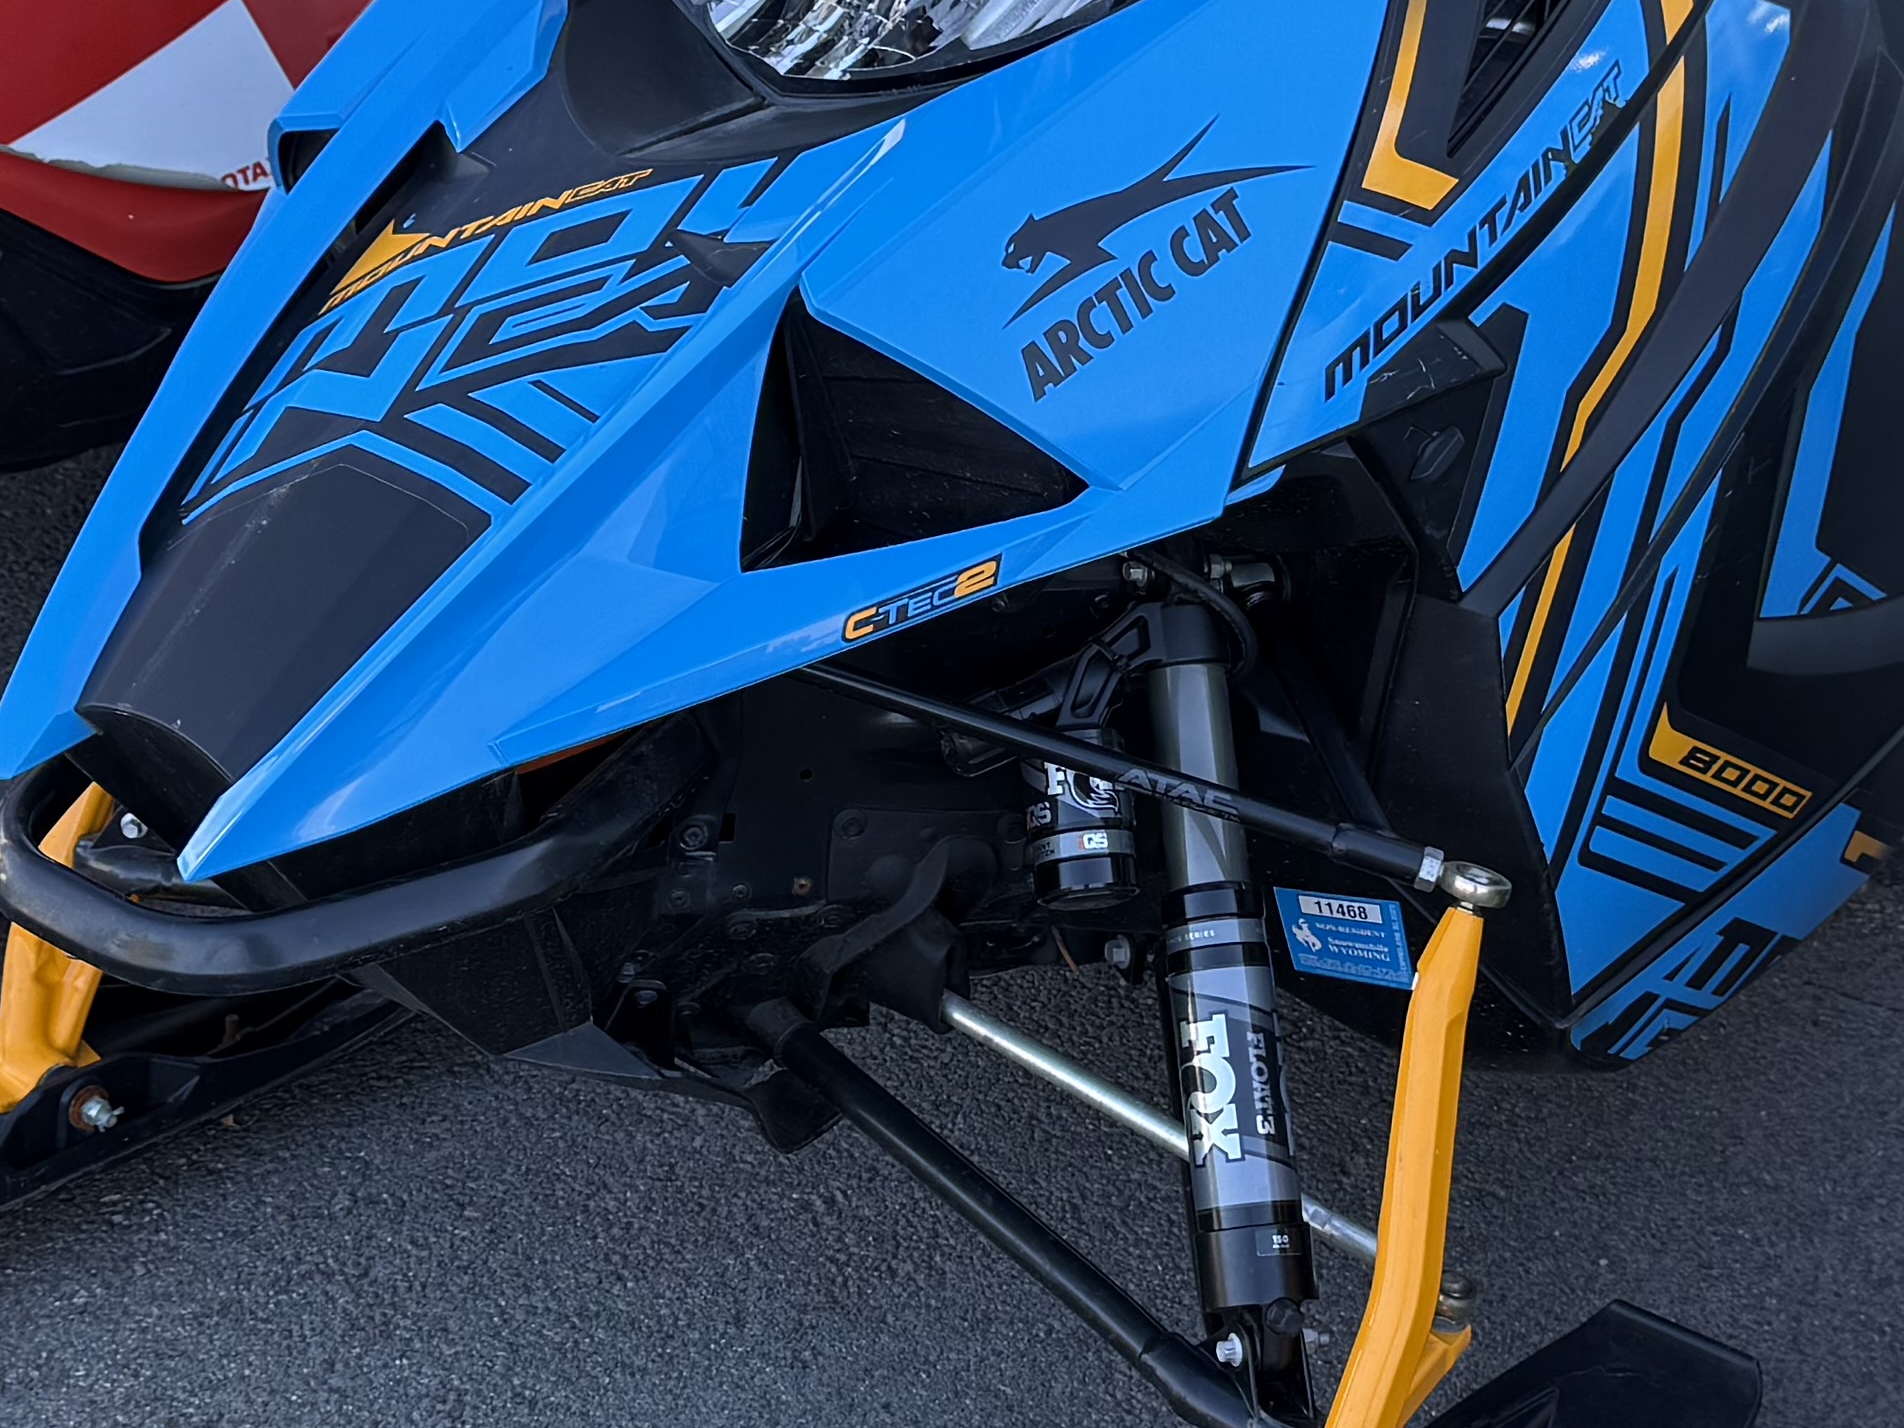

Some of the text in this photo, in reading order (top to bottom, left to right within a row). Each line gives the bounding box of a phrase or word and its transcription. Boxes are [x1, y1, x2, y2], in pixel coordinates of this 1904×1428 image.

[221, 160, 270, 189] OTA
[1019, 187, 1253, 403] ARCTIC CAT
[1677, 745, 1806, 813] 8000
[1314, 900, 1368, 920] 11468
[1327, 936, 1390, 953] Snowmobile
[1328, 944, 1391, 962] WYOMING
[1180, 1013, 1243, 1167] FOX
